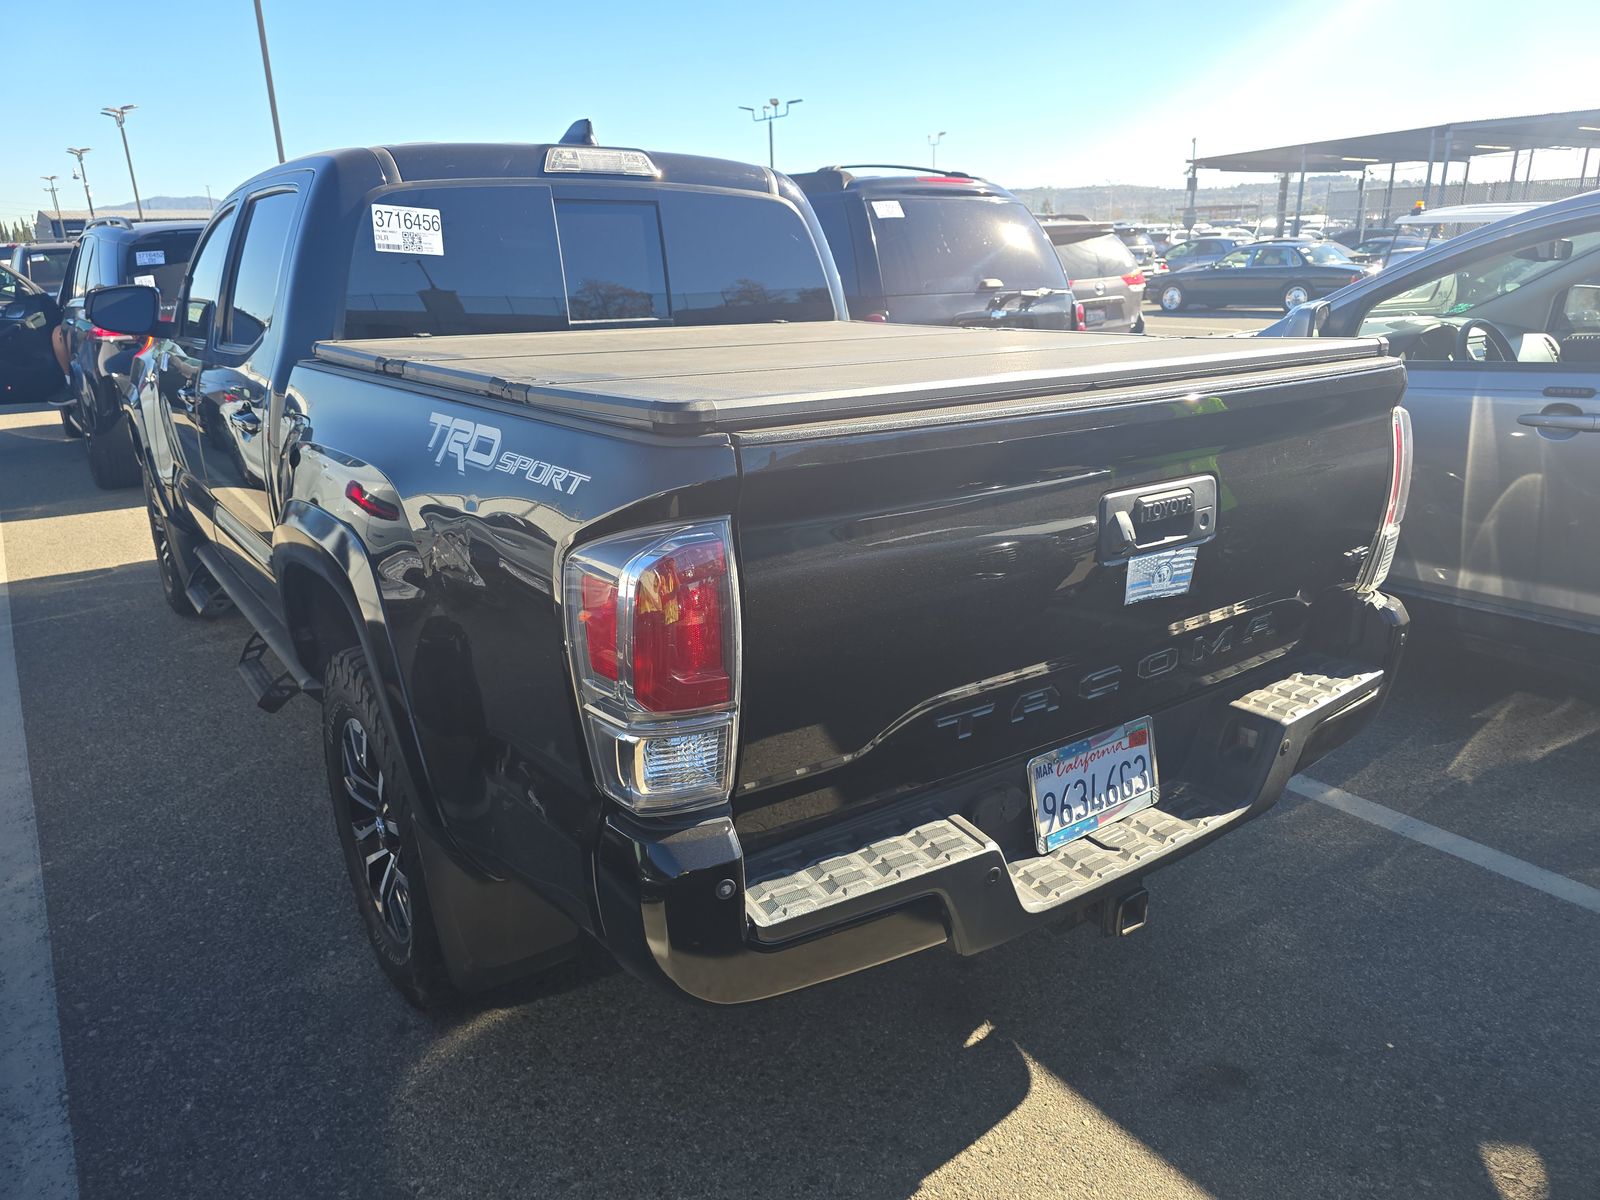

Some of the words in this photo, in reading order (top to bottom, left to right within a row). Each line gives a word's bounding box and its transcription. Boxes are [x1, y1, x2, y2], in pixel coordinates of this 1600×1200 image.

[375, 210, 440, 231] 3716456
[428, 412, 502, 477] TRD
[495, 451, 592, 495] SPORT
[1143, 494, 1192, 522] TOYOTA
[935, 610, 1273, 739] TACOMA
[1035, 763, 1054, 780] MAR
[1056, 741, 1129, 777] California
